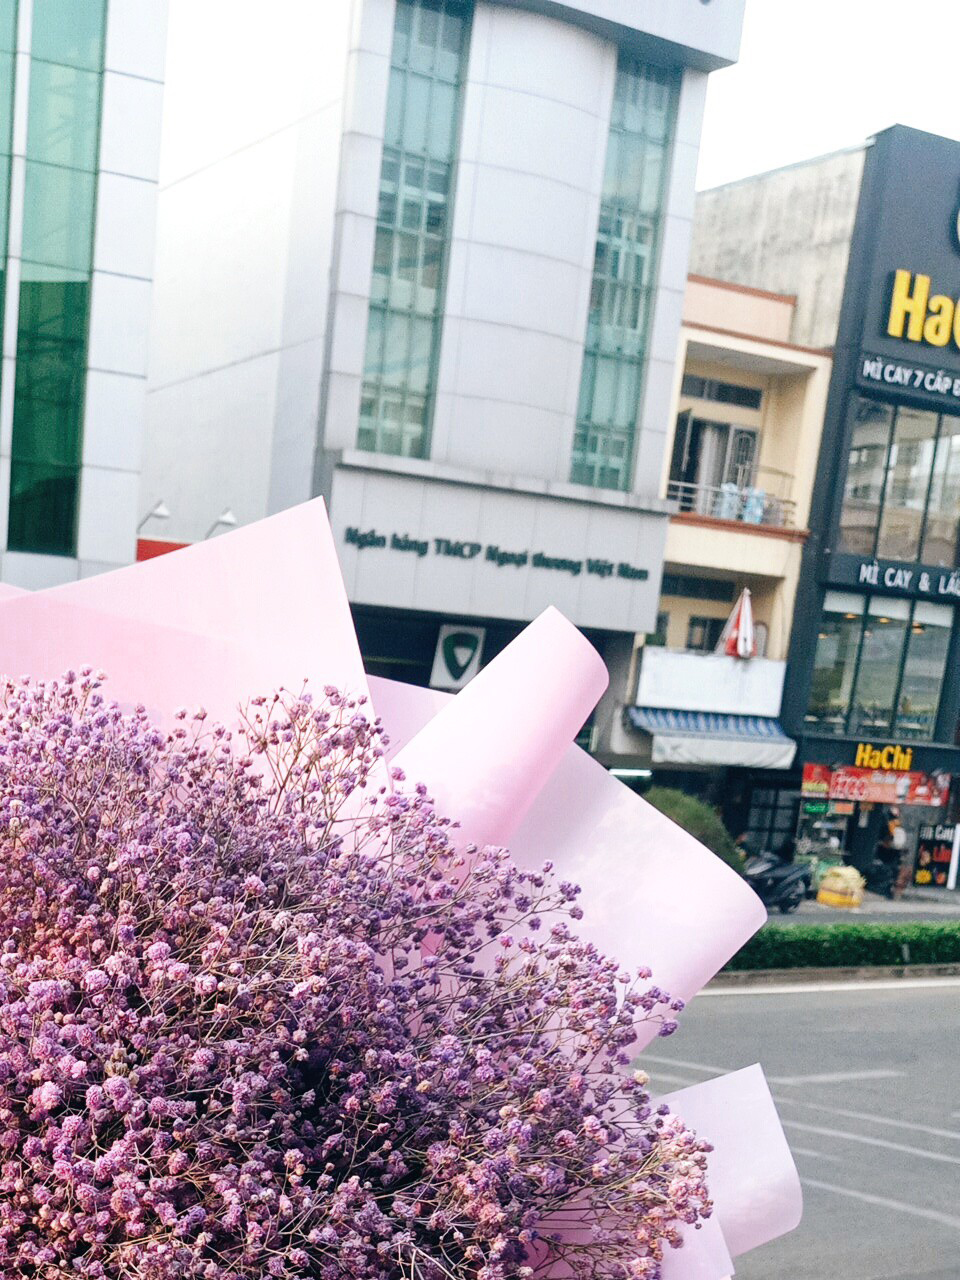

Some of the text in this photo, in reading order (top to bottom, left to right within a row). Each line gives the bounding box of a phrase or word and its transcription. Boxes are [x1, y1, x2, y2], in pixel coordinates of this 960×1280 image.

[887, 268, 960, 349] Ha
[863, 356, 883, 380] MÌ
[884, 364, 913, 387] CAY
[913, 370, 925, 388] 7
[859, 559, 879, 585] MÌ
[884, 567, 913, 589] CAY
[919, 572, 930, 592] &
[855, 743, 913, 771] HaChi
